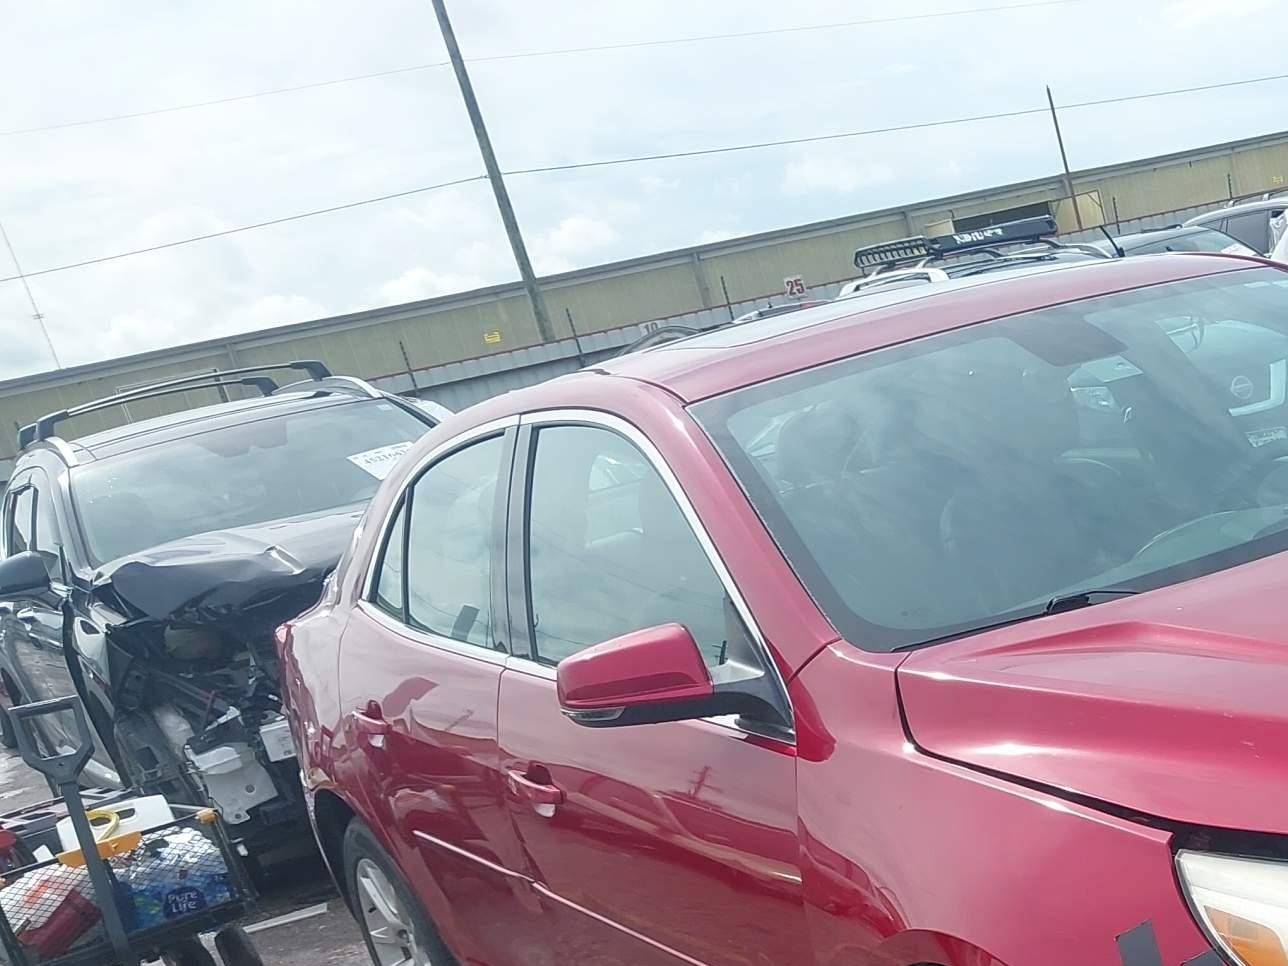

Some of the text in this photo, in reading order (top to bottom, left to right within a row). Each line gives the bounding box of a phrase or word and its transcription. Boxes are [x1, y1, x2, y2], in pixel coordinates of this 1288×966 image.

[786, 279, 805, 296] 25
[168, 891, 198, 905] Pure
[172, 901, 197, 913] Life
